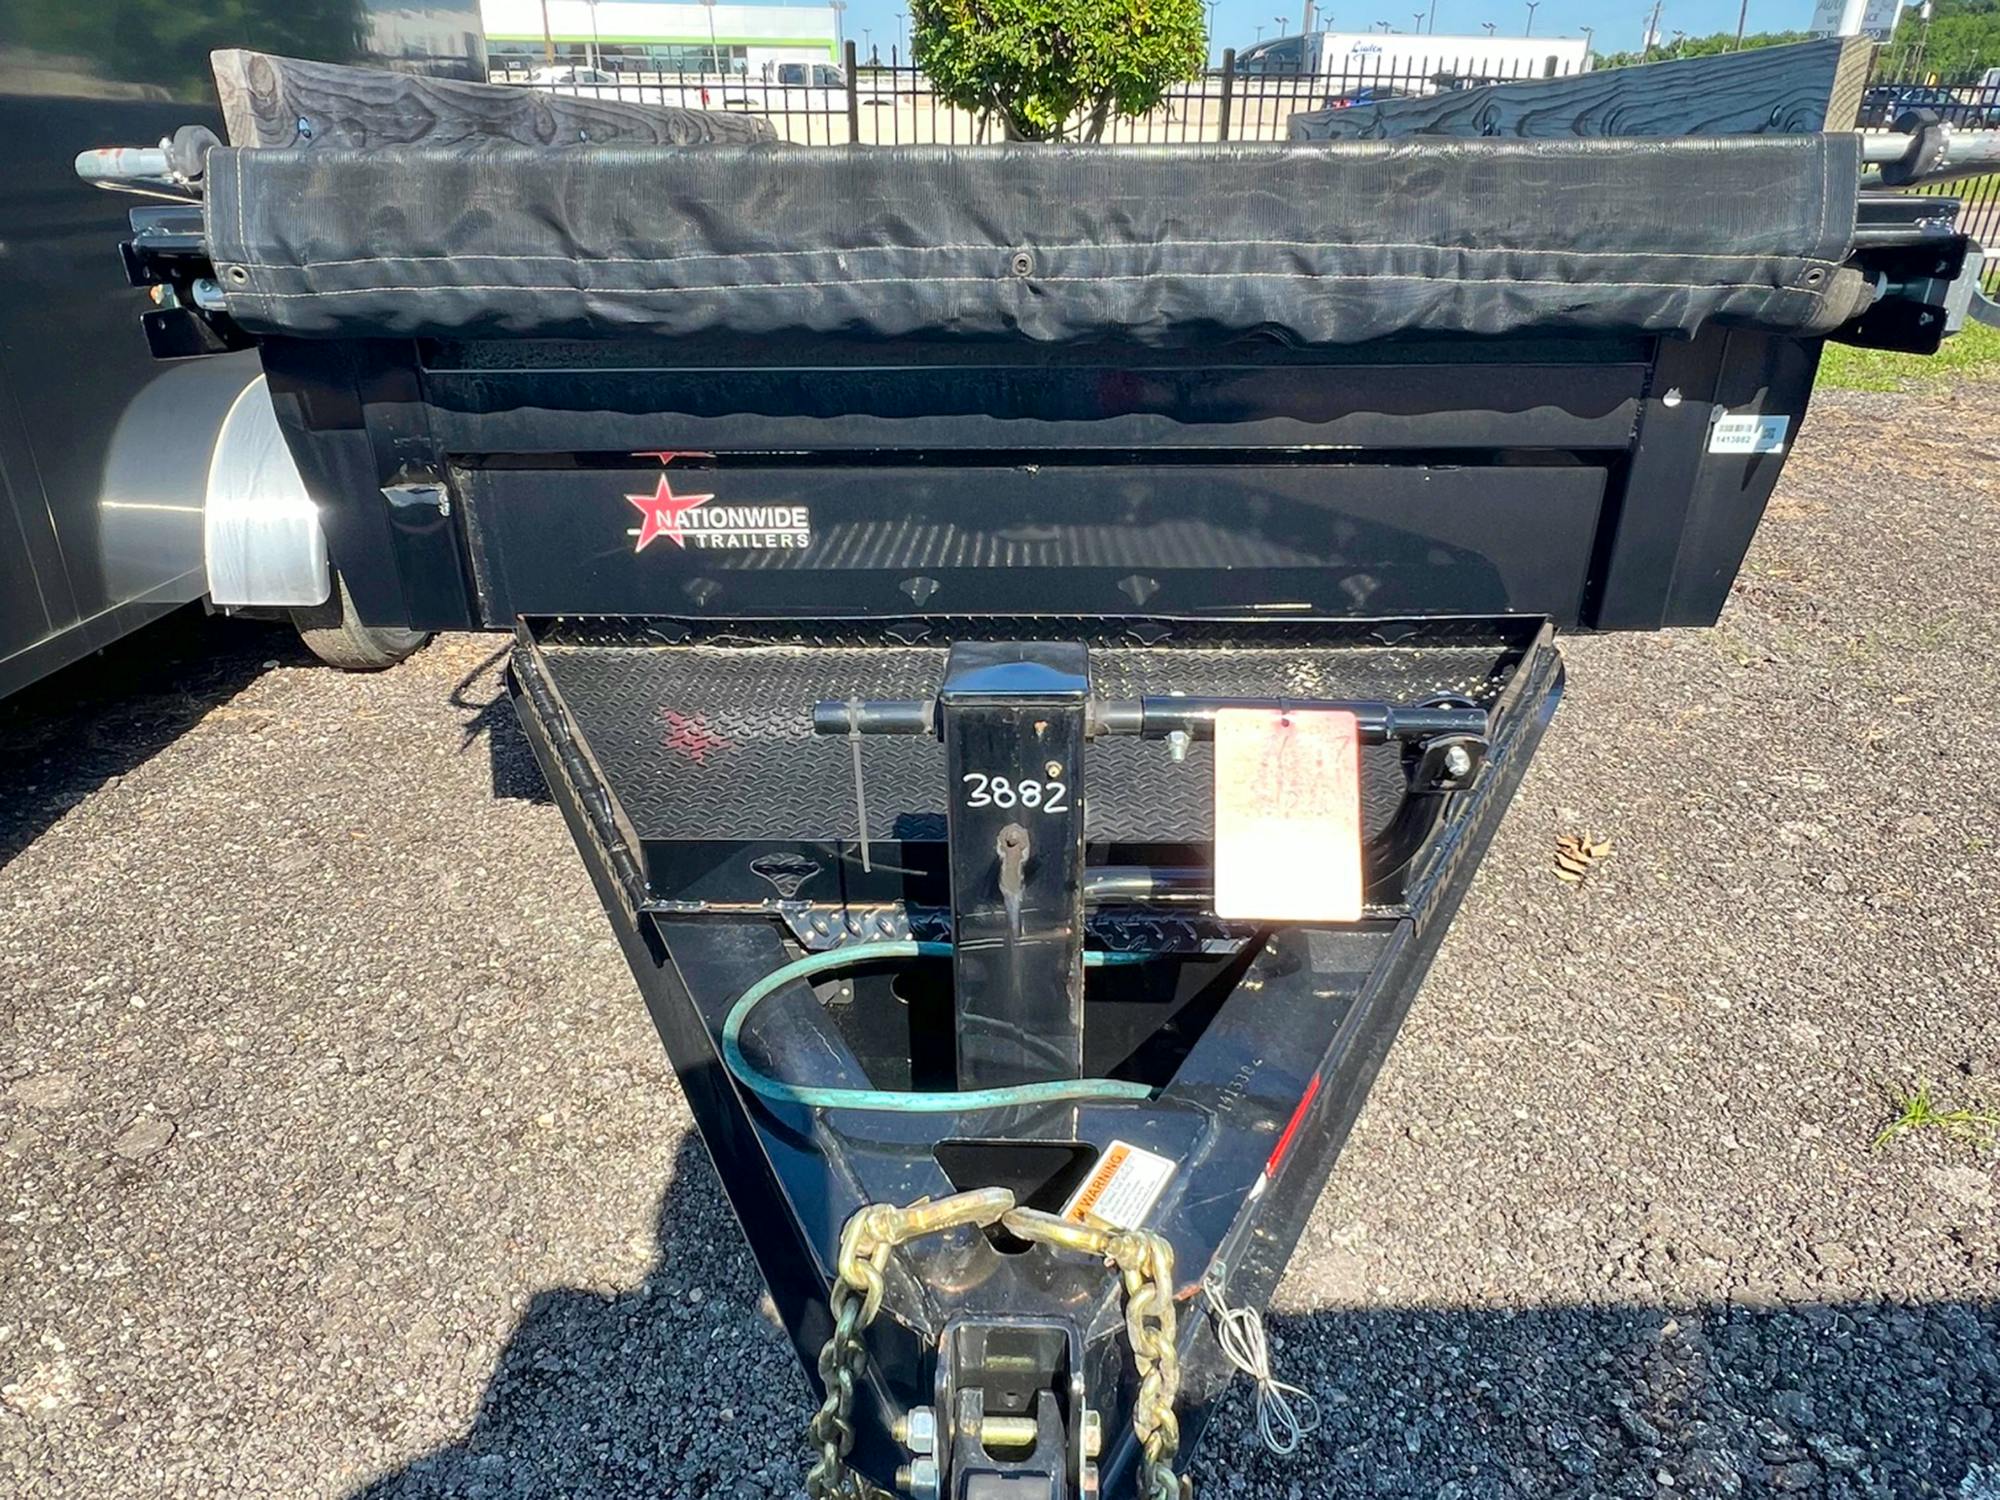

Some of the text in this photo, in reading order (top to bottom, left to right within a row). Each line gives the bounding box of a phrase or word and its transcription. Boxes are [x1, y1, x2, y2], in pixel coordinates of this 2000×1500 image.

[656, 507, 809, 528] NATIONWIDE
[697, 534, 809, 549] TRAILERS
[963, 773, 1068, 813] 3882
[1080, 1154, 1123, 1208] WARNING
